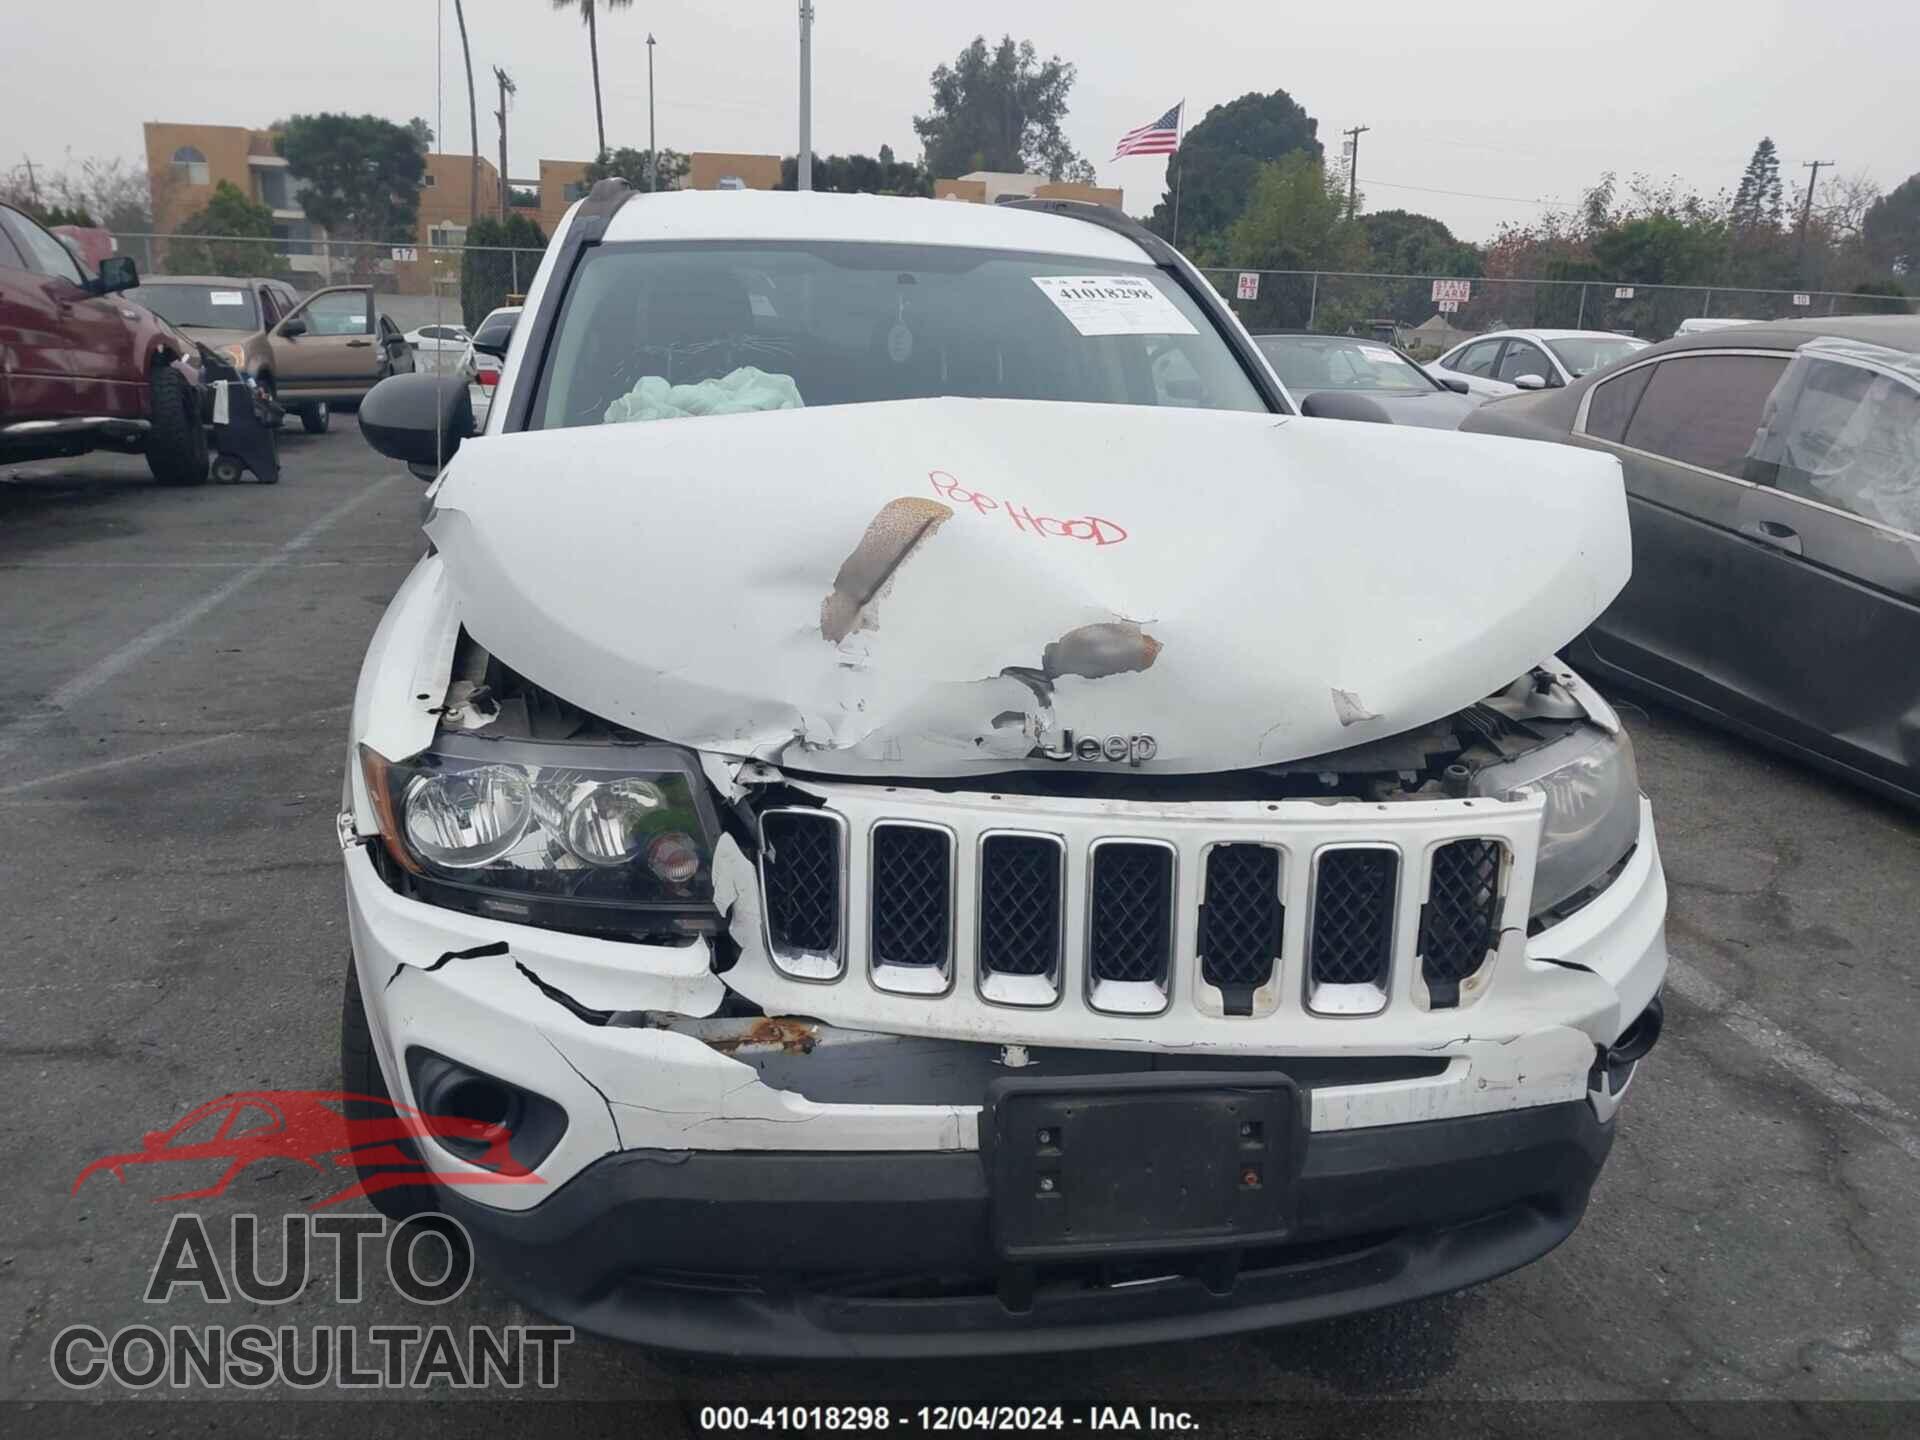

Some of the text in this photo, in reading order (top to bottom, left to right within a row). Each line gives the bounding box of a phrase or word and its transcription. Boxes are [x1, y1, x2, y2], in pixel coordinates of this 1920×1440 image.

[1434, 280, 1470, 289] STATE
[1059, 287, 1153, 300] 41018298
[1435, 289, 1467, 298] FARM
[1443, 302, 1455, 311] 12
[1045, 728, 1158, 767] Jeep
